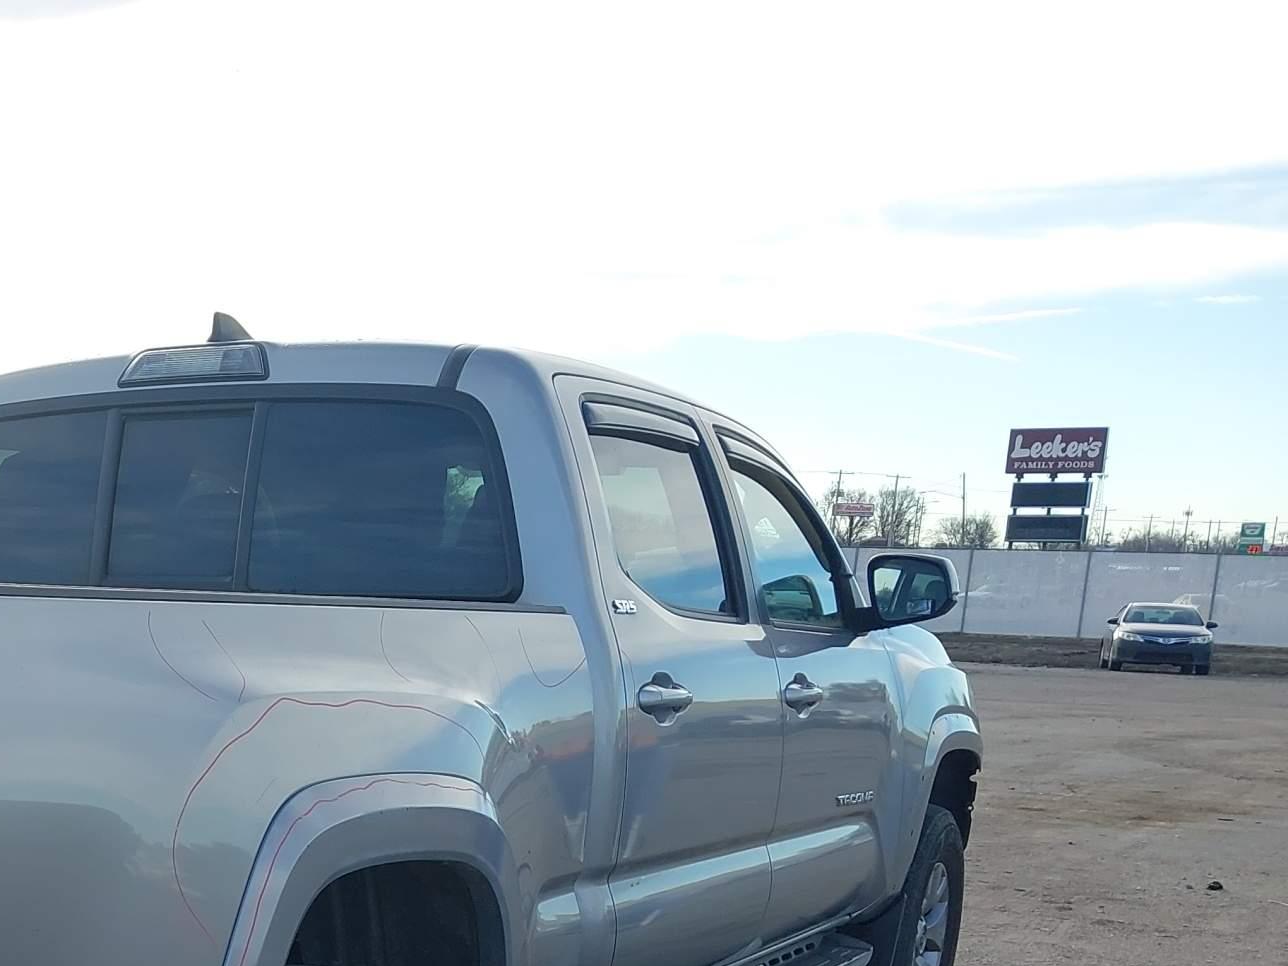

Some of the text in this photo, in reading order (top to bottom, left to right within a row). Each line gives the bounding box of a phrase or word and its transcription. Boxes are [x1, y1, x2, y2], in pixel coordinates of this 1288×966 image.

[1011, 433, 1103, 458] Leeker's
[1014, 460, 1095, 469] FAMILY FOODS
